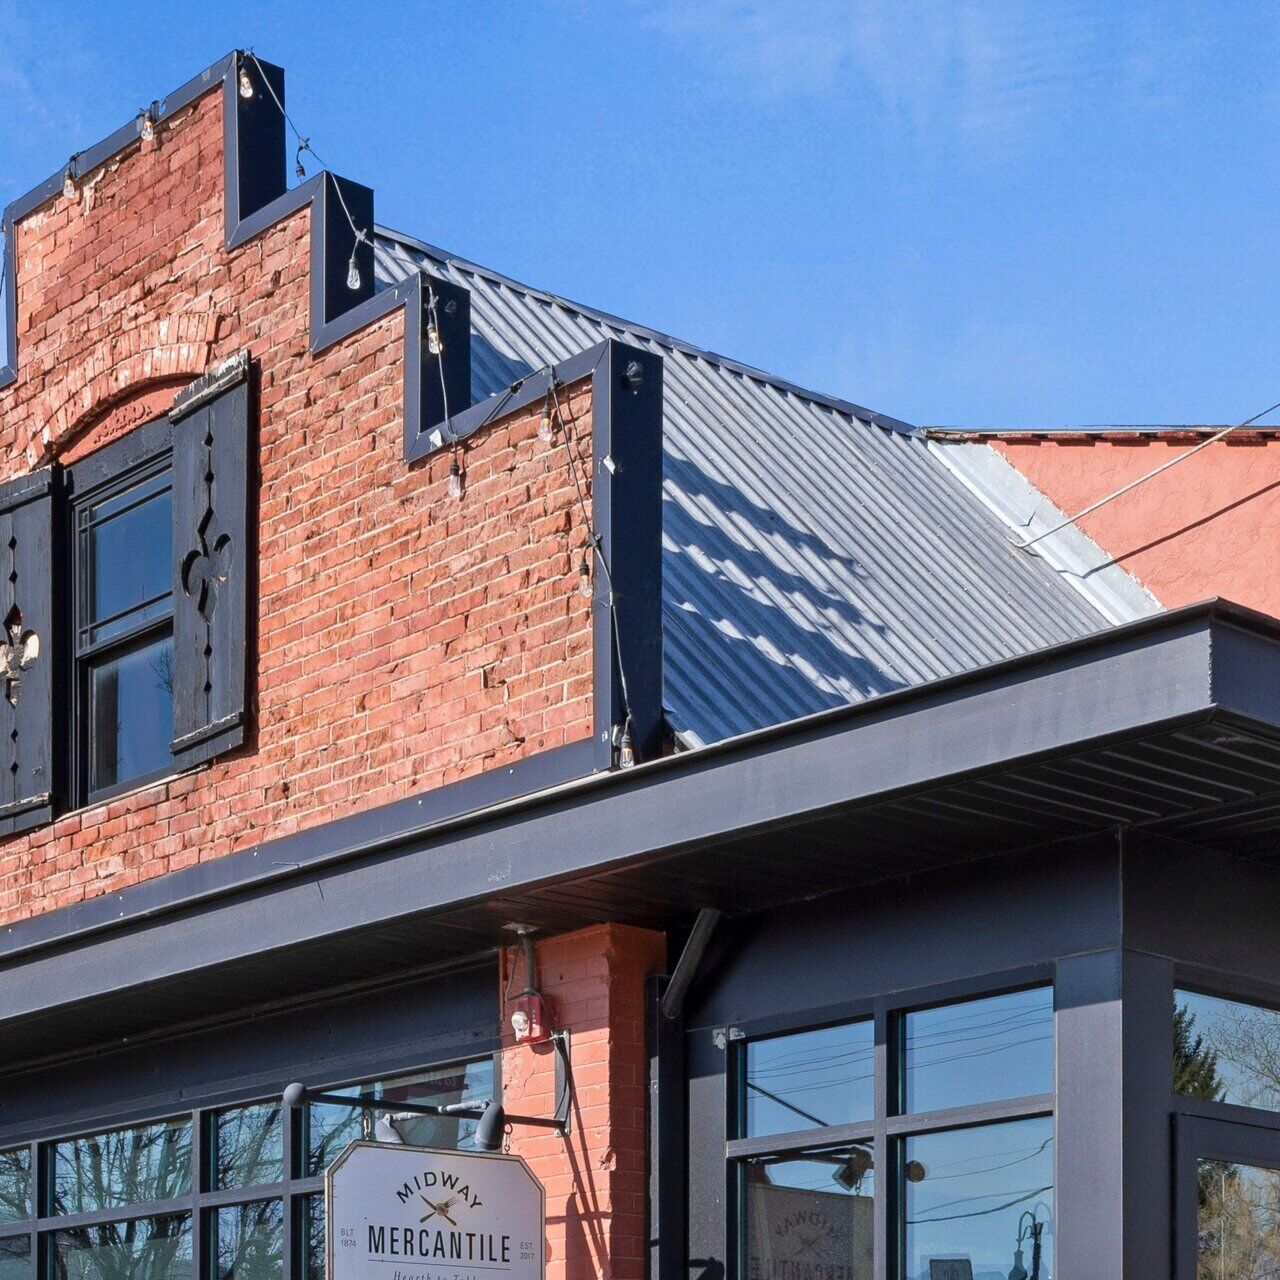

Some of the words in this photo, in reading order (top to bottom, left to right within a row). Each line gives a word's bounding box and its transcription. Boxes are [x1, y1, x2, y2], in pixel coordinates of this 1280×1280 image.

[395, 1170, 483, 1210] MIDWAY
[340, 1239, 356, 1248] 1874
[368, 1225, 511, 1263] MERCANTILE
[520, 1252, 535, 1261] 2017
